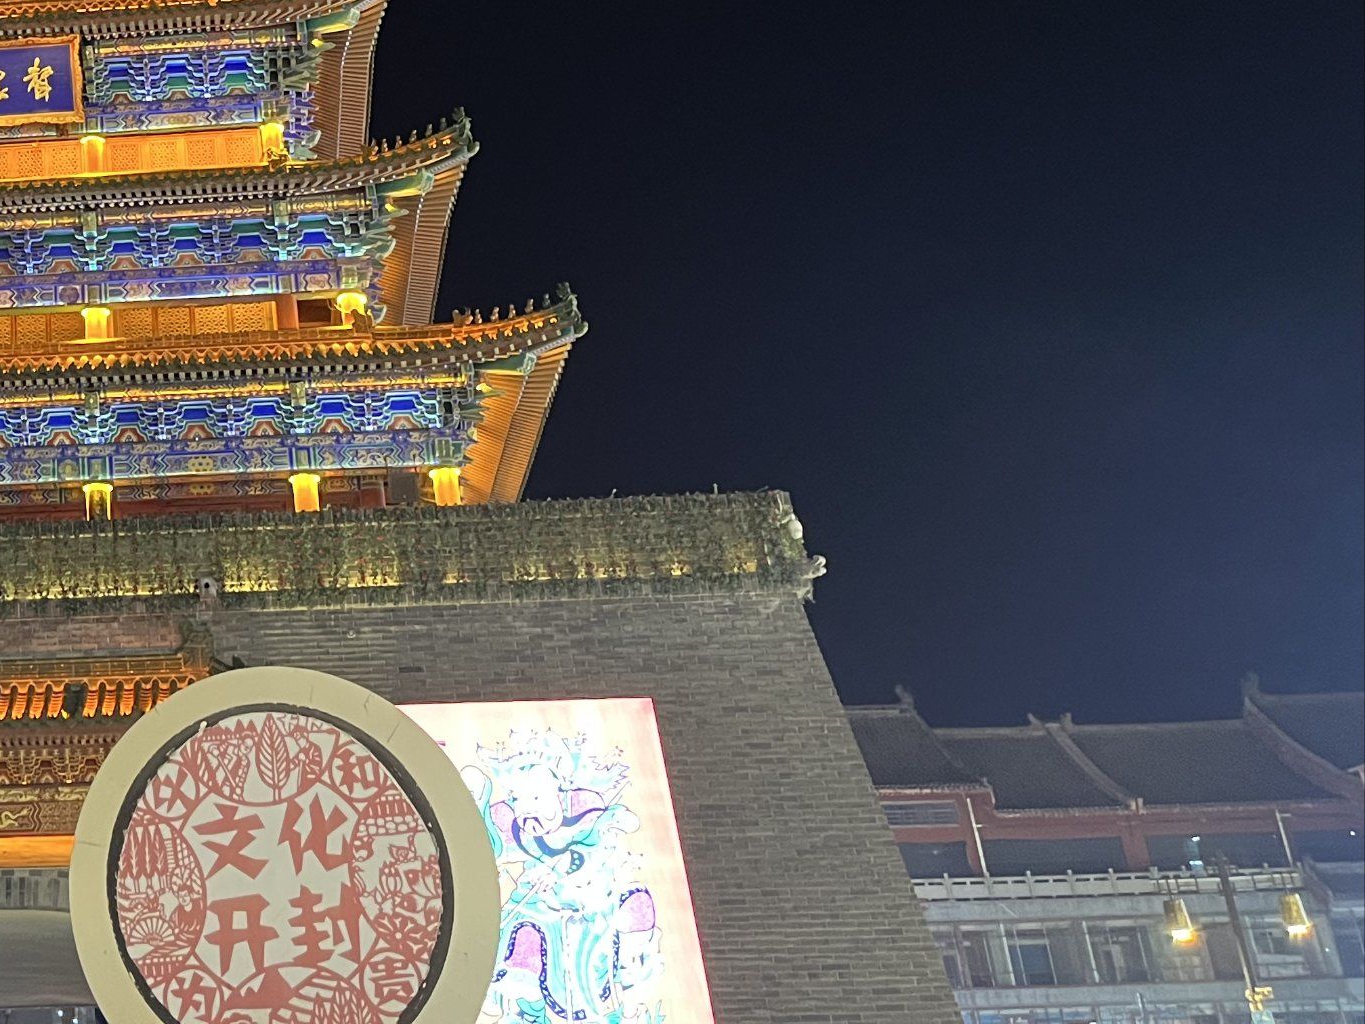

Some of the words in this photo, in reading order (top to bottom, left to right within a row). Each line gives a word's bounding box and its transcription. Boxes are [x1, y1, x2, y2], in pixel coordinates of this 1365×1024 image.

[192, 791, 354, 880] 文化
[204, 880, 363, 978] 开封
[367, 956, 416, 1007] 贵
